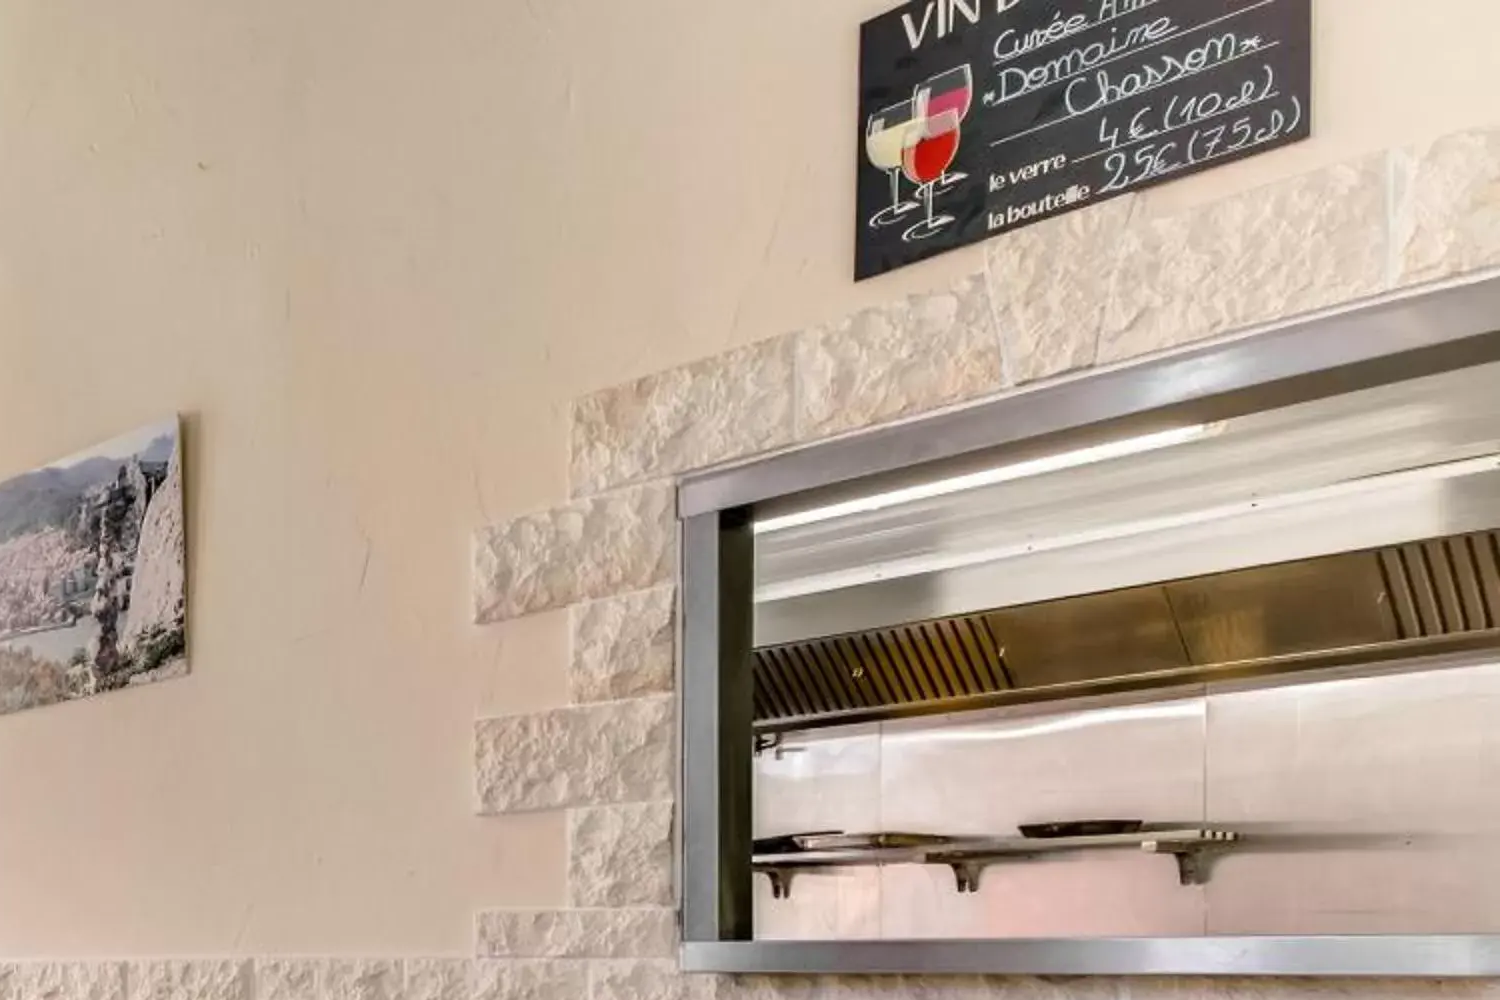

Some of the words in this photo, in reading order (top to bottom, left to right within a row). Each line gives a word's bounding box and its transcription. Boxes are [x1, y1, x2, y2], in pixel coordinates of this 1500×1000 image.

[901, 0, 980, 50] VIN
[994, 10, 1087, 58] Cuvée
[999, 17, 1179, 101] Domaine
[1065, 33, 1236, 115] Chasson
[988, 173, 1006, 193] le
[1009, 153, 1067, 184] verre
[987, 212, 1005, 230] la
[1007, 184, 1091, 224] bouteille
